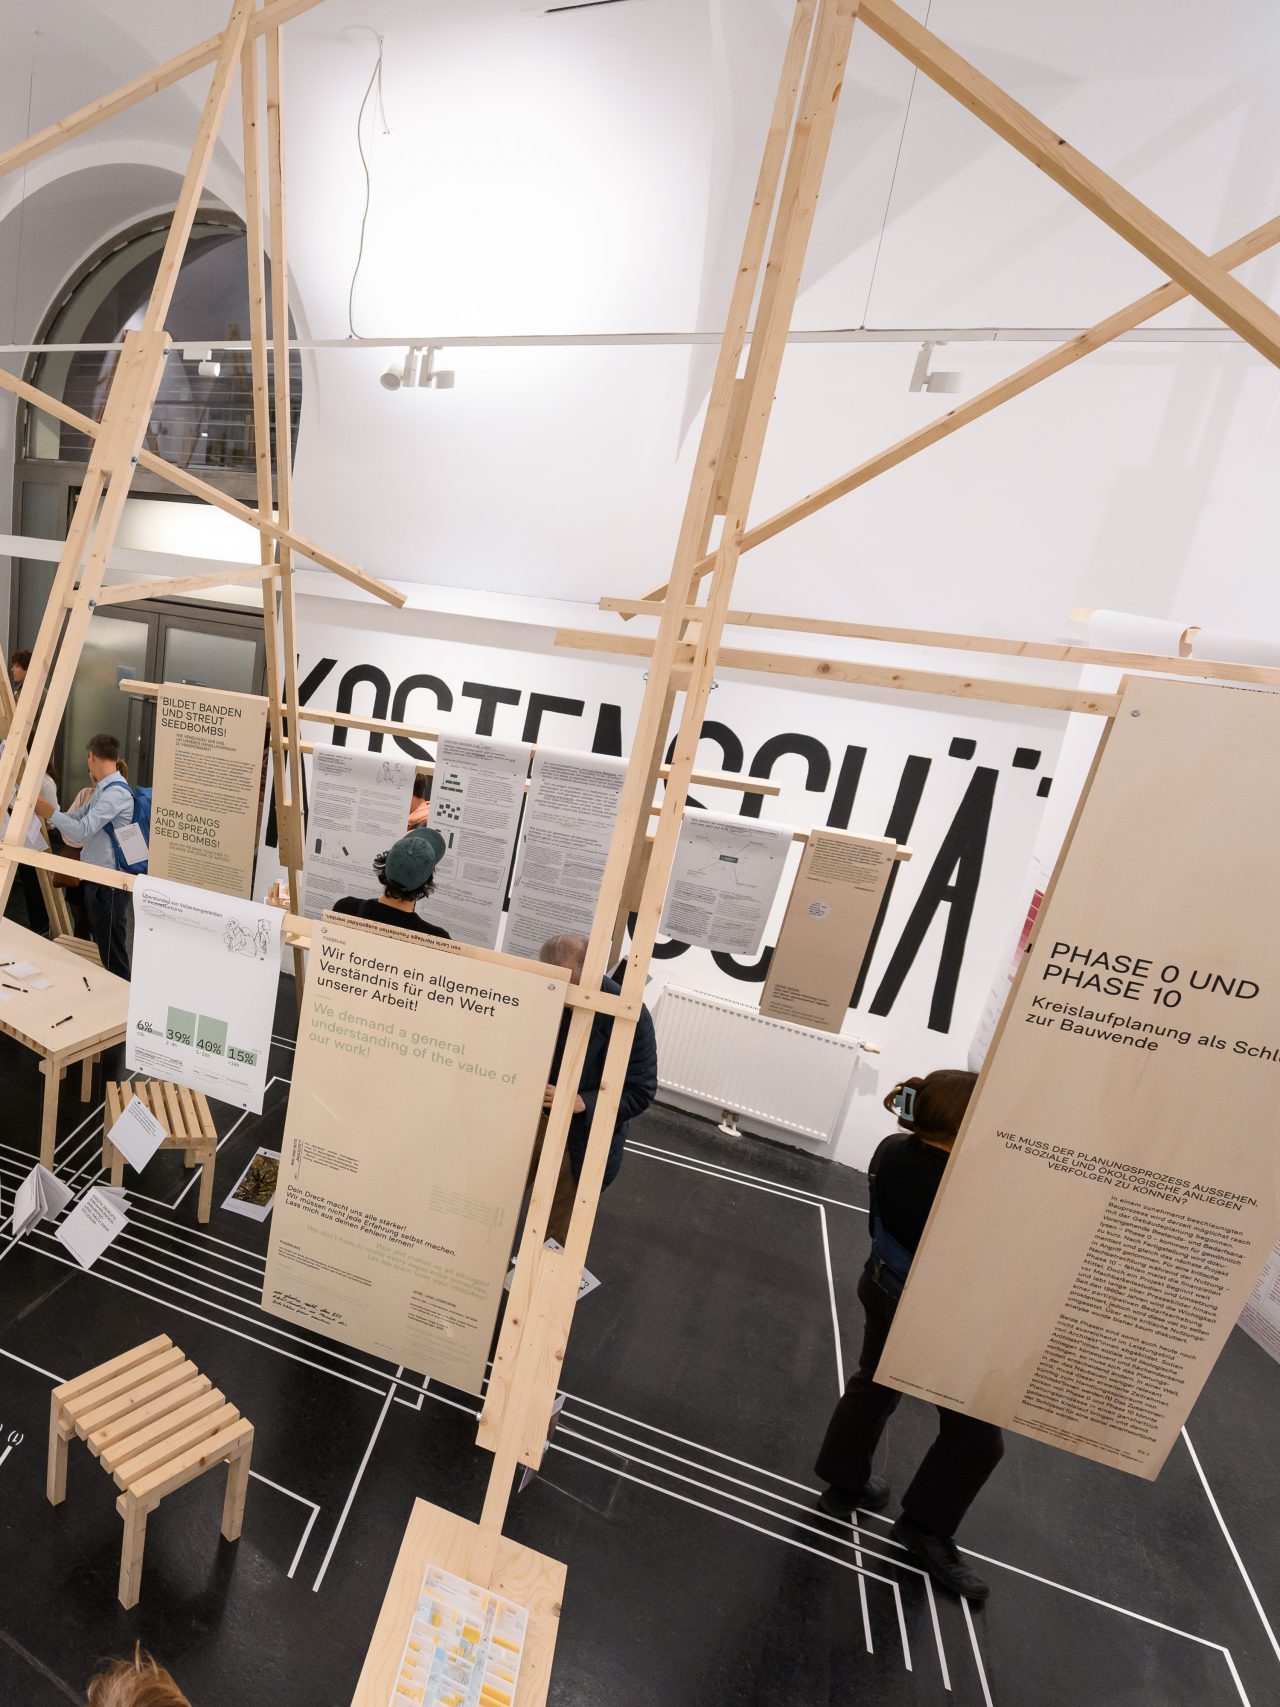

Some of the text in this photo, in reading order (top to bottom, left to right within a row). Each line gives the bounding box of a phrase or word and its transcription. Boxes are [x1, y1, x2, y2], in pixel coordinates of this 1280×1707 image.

[161, 715, 226, 737] SEEDBOMBS!
[162, 707, 225, 726] UND STREUT
[163, 697, 242, 718] BILDET BANDEN
[155, 817, 216, 837] AND SPREAD
[155, 826, 179, 839] SEED
[182, 832, 220, 848] BOMBS!
[156, 807, 220, 829] FORM GANGS
[320, 959, 495, 1017] Verständnis für den Wert
[322, 944, 519, 1007] Wir fordern ein allgemeines
[1043, 964, 1181, 1008] PHASE 10
[1050, 942, 1259, 999] PHASE 0 UND
[317, 977, 418, 1011] unserer Arbeit!
[137, 1020, 254, 1065] 6% 39% 40% 15%
[309, 1031, 371, 1058] our work!
[314, 1001, 465, 1055] We demand a general
[1025, 1013, 1158, 1051] zur Bauwende
[1032, 995, 1280, 1062] Kreislaufplanung als Schl
[311, 1019, 517, 1084] understanding of the value of
[997, 1130, 1016, 1141] WIE
[1018, 1136, 1050, 1150] MUSS
[1052, 1145, 1075, 1157] DER
[1077, 1152, 1190, 1188] PLANUNGSPROZESS
[1005, 1141, 1022, 1151] UM
[1024, 1147, 1069, 1164] SOZIALE
[1072, 1159, 1096, 1171] UND
[1182, 1190, 1242, 1211] ANLIEGEN
[287, 1184, 303, 1195] Dein
[304, 1191, 325, 1203] Dreck
[326, 1200, 349, 1211] macht
[349, 1209, 362, 1217] uns
[1048, 1161, 1188, 1205] VERFOLGEN ZU KÖNNEN?
[285, 1198, 300, 1208] Lass
[302, 1205, 319, 1215] mich
[321, 1212, 333, 1220] aus
[335, 1217, 358, 1229] deinen
[360, 1225, 387, 1239] Fehlern
[287, 1192, 298, 1200] Wir
[300, 1197, 326, 1210] müssen
[327, 1208, 345, 1217] nicht
[345, 1214, 362, 1223] jede
[363, 1219, 399, 1237] Erfahrung
[401, 1233, 423, 1245] selbst
[8, 1430, 24, 1446] (1)
